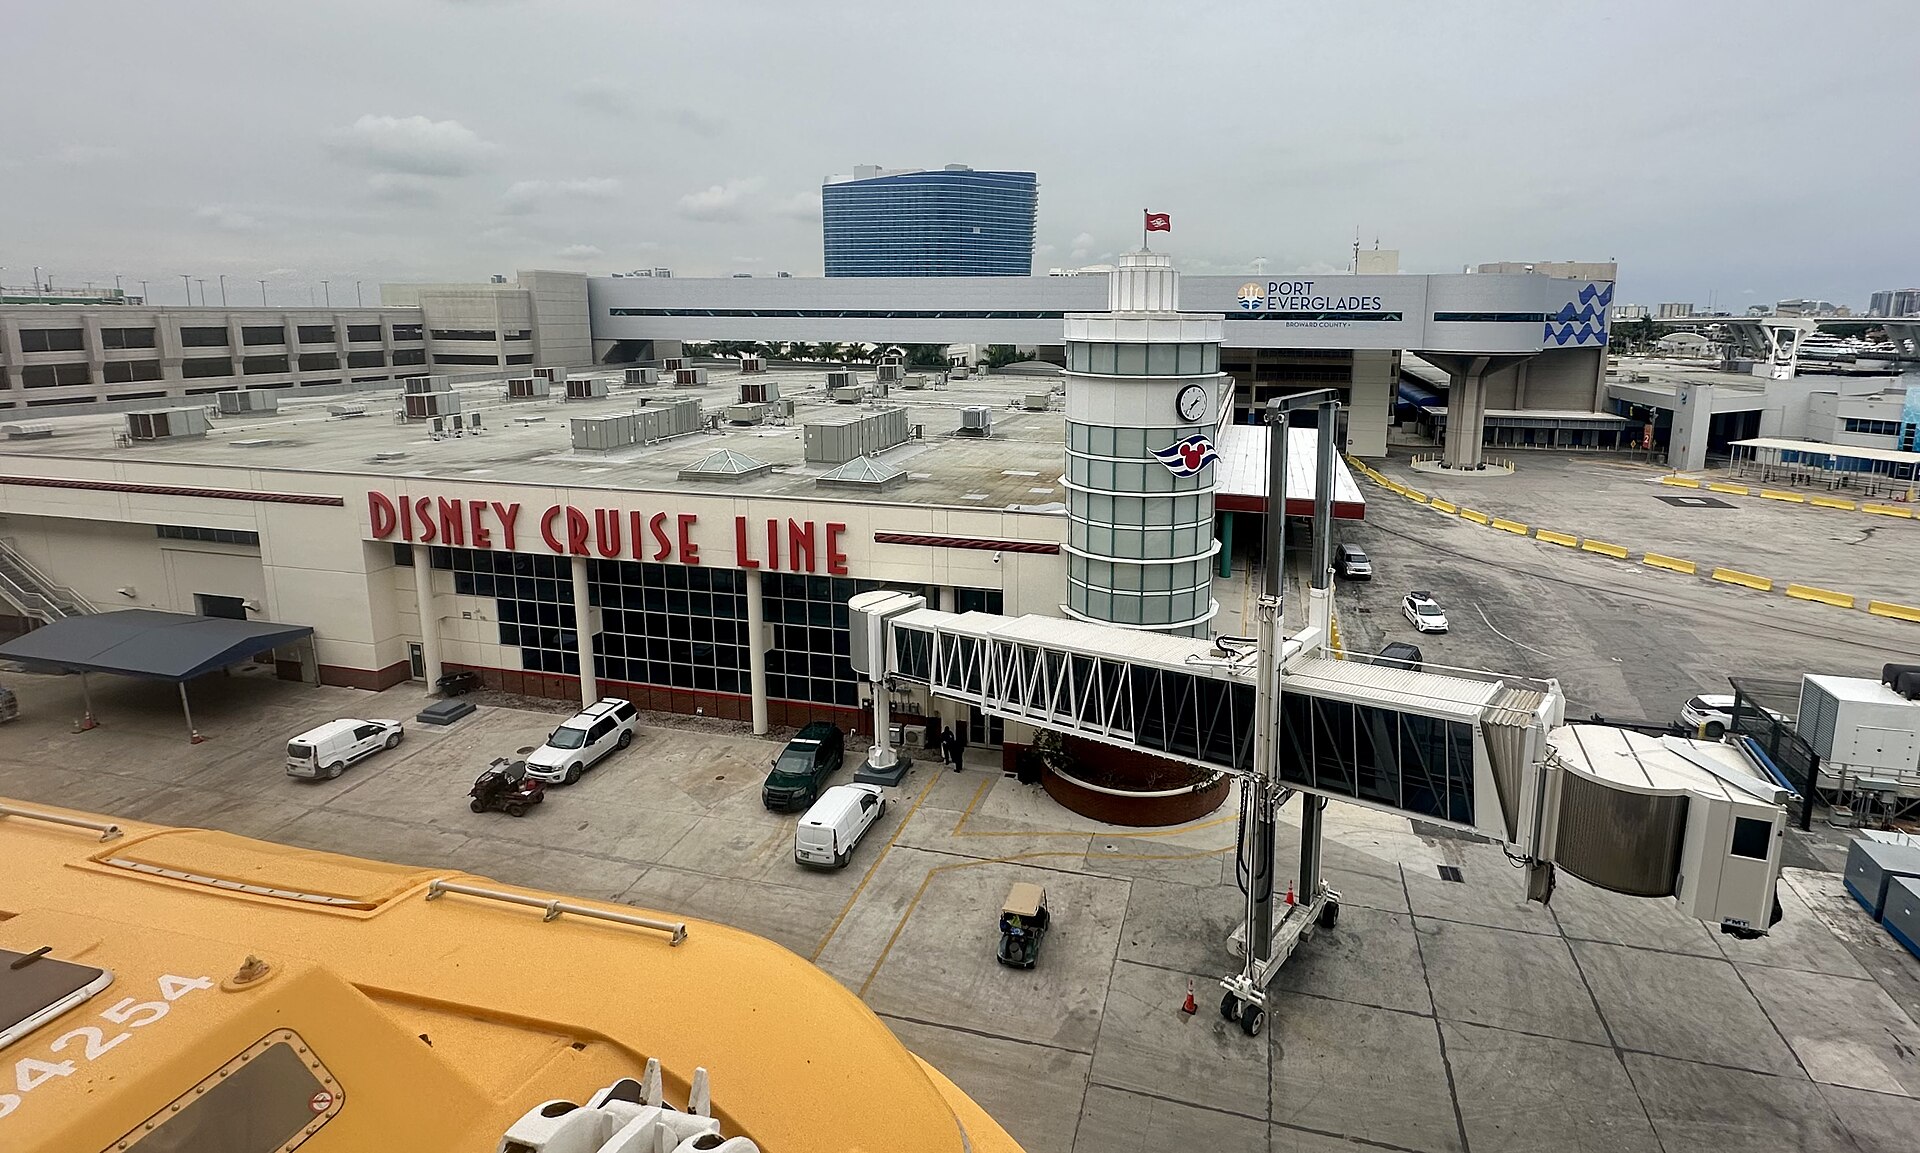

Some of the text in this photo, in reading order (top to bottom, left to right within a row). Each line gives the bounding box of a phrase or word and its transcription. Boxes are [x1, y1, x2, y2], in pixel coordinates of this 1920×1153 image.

[1267, 281, 1314, 295] PORT
[1267, 297, 1382, 310] EVERGLADES
[367, 491, 848, 575] DISNEY CRUISE LINE
[1724, 918, 1748, 927] FMT
